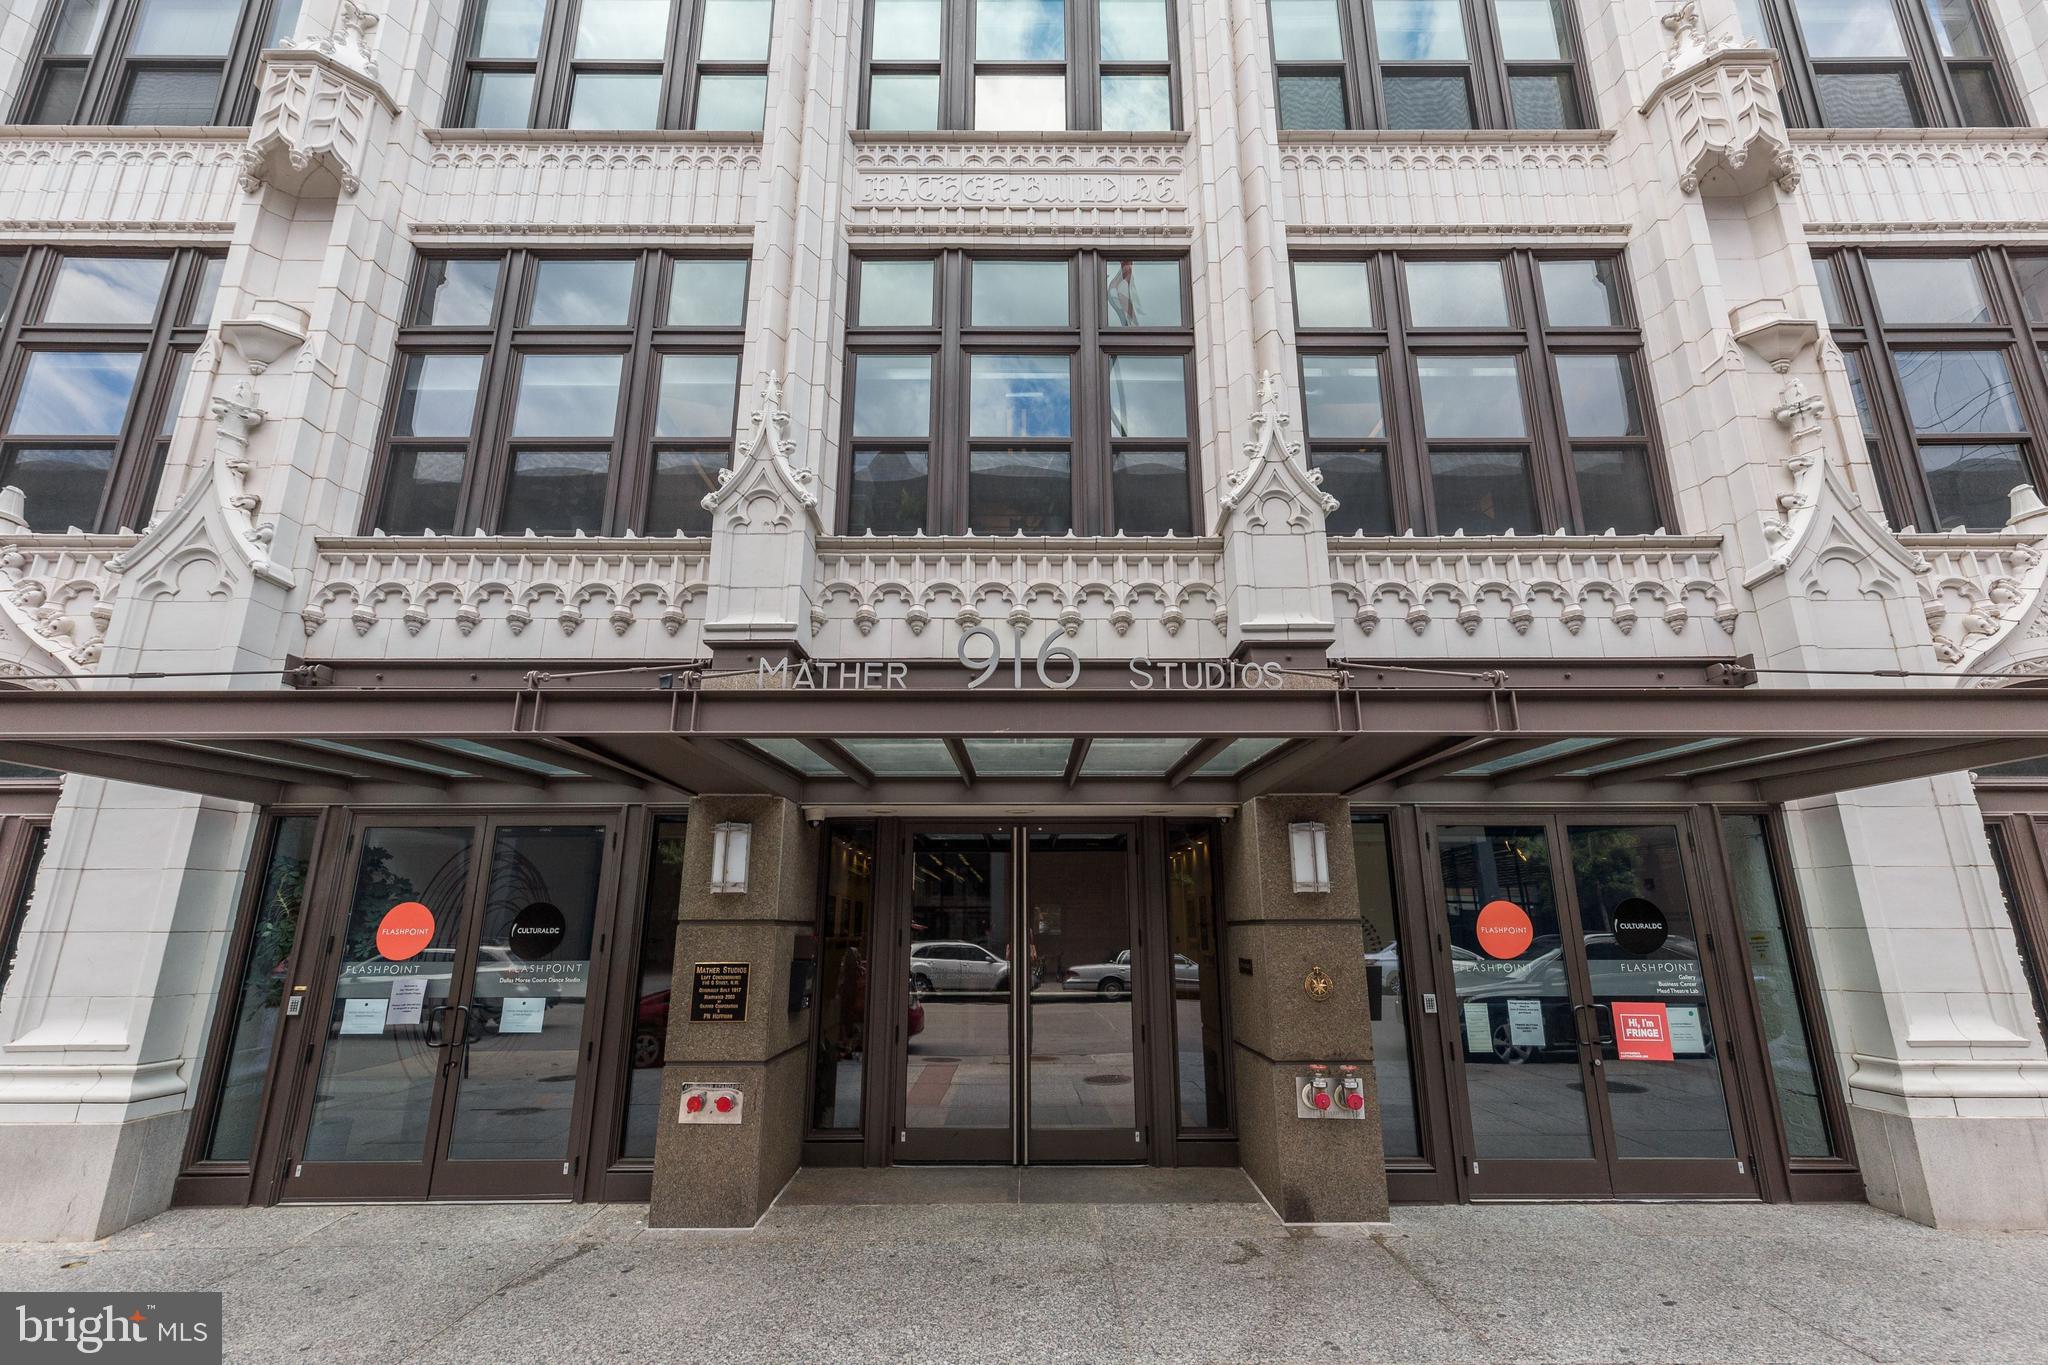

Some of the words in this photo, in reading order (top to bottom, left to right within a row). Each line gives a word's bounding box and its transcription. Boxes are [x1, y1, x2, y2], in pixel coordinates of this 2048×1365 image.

[759, 656, 908, 689] MATHER
[958, 627, 1080, 689] 916
[1129, 657, 1283, 689] STUDIOS
[382, 928, 429, 936] FLASHPOINT
[1481, 926, 1528, 935] FLASHPOINT
[345, 964, 421, 975] FLASHPOINT
[696, 966, 721, 974] MATHER
[722, 966, 748, 974] STUDIOS
[1620, 962, 1694, 973] FLASHPOINT
[1628, 1018, 1640, 1028] Hi,
[1641, 1018, 1654, 1028] I'm
[1626, 1028, 1660, 1038] FRINGE
